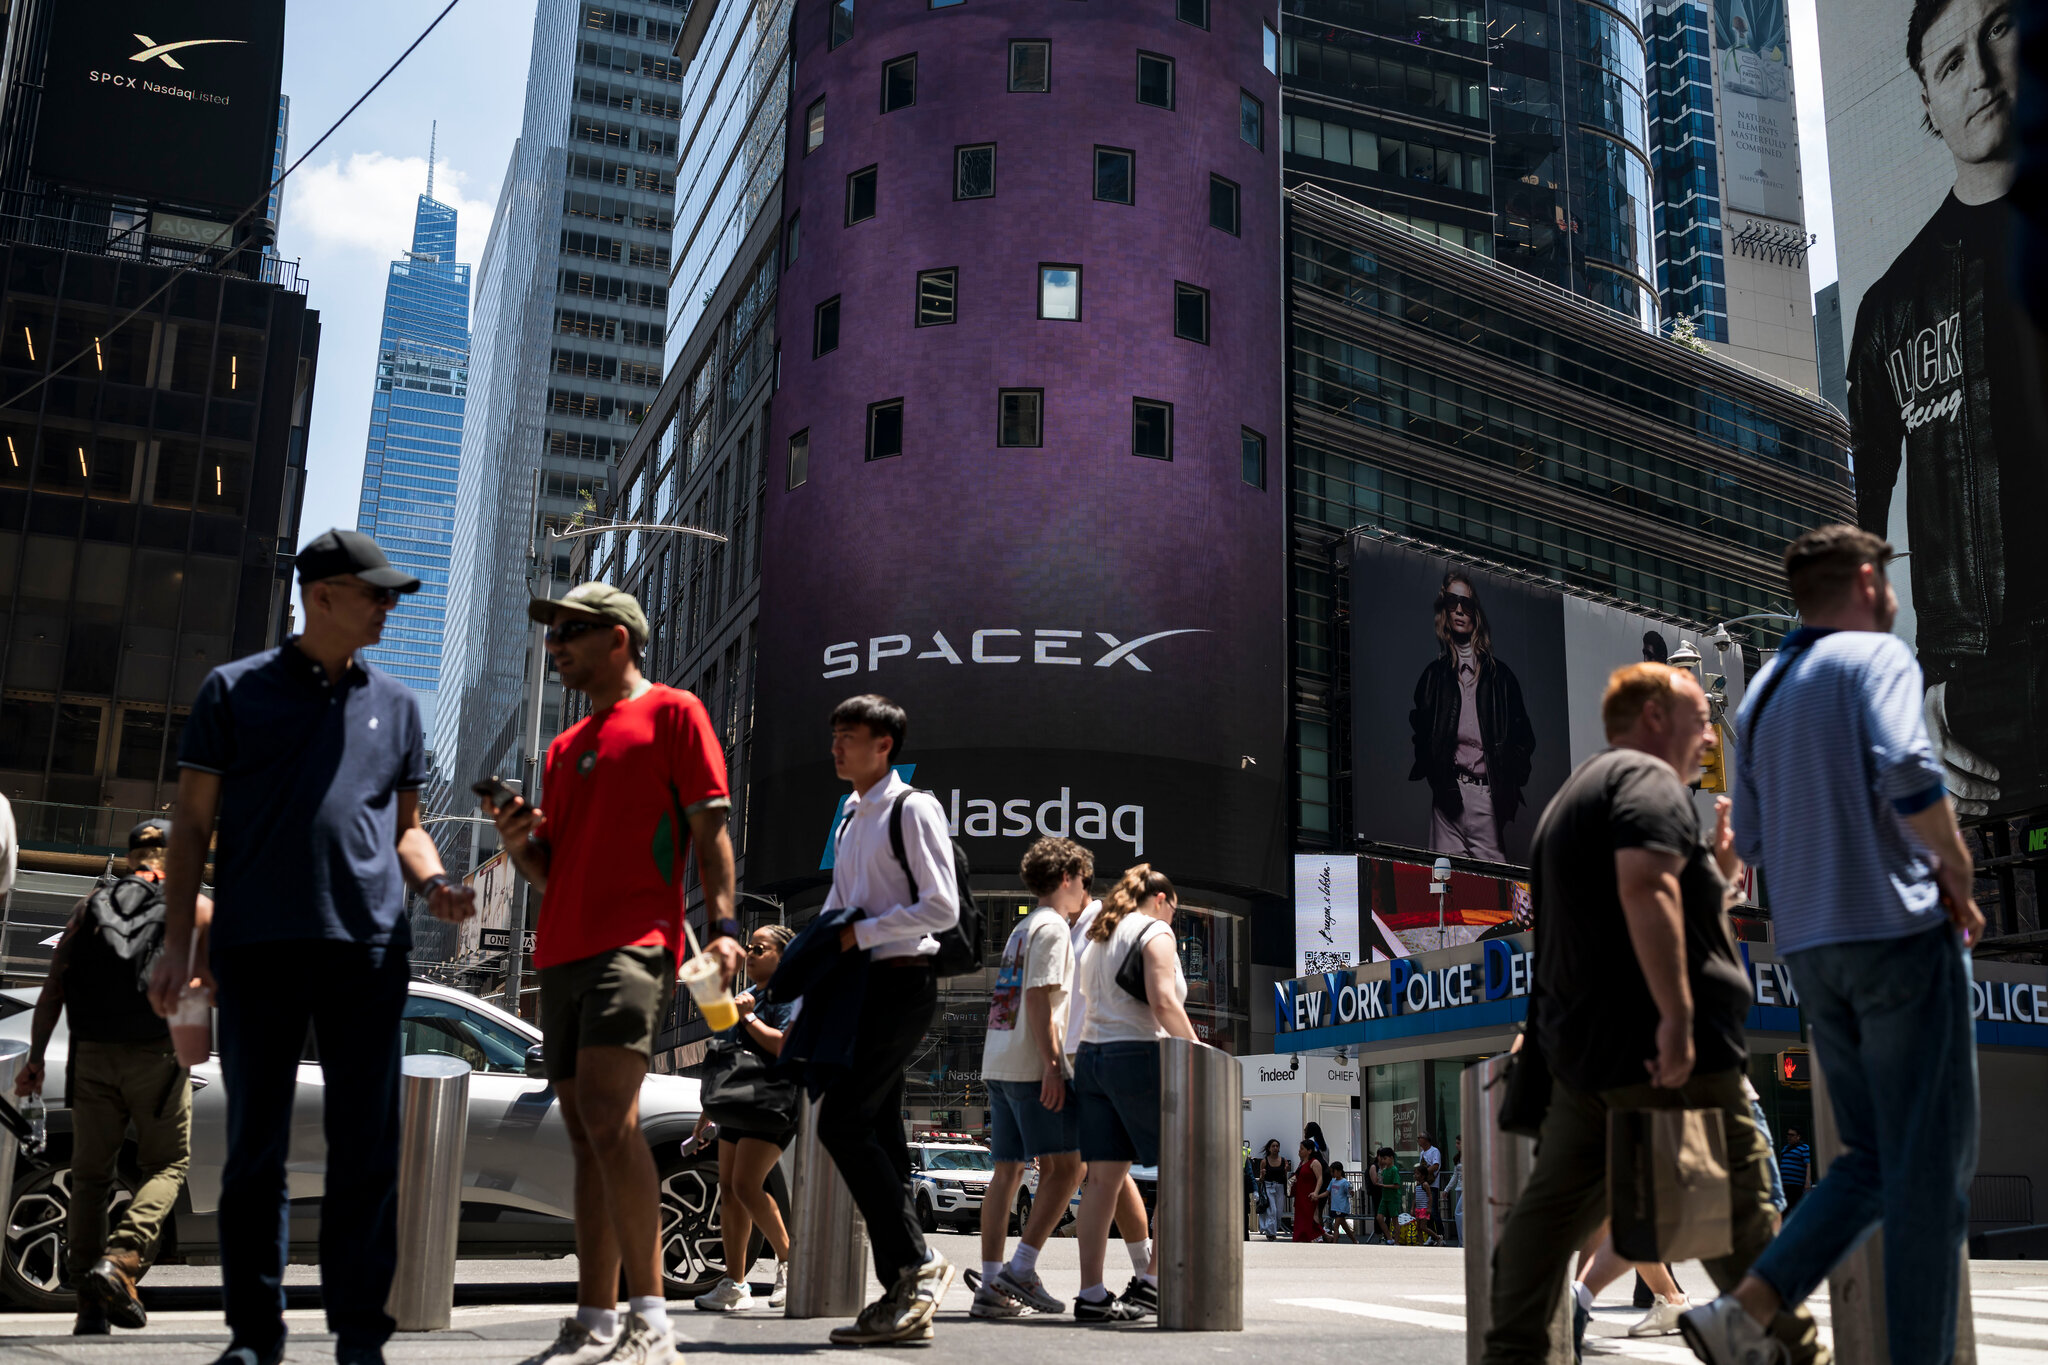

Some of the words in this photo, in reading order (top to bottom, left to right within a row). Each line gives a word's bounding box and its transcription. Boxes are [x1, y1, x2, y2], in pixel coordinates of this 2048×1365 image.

[89, 70, 137, 89] SPCX
[1738, 111, 1777, 127] NATURAL
[1737, 121, 1779, 137] ELEMENTS
[1730, 130, 1788, 149] MASTERFULLY
[1736, 141, 1784, 159] COMBINED.
[822, 628, 1215, 680] SPACEX
[490, 935, 510, 946] ONE
[1274, 981, 1324, 1034] NEW
[1324, 970, 1385, 1026] YORK
[1390, 958, 1474, 1015] POLICE
[1968, 980, 2048, 1024] OLICE
[948, 1070, 983, 1081] Nasda
[1327, 1070, 1354, 1082] CHIEF
